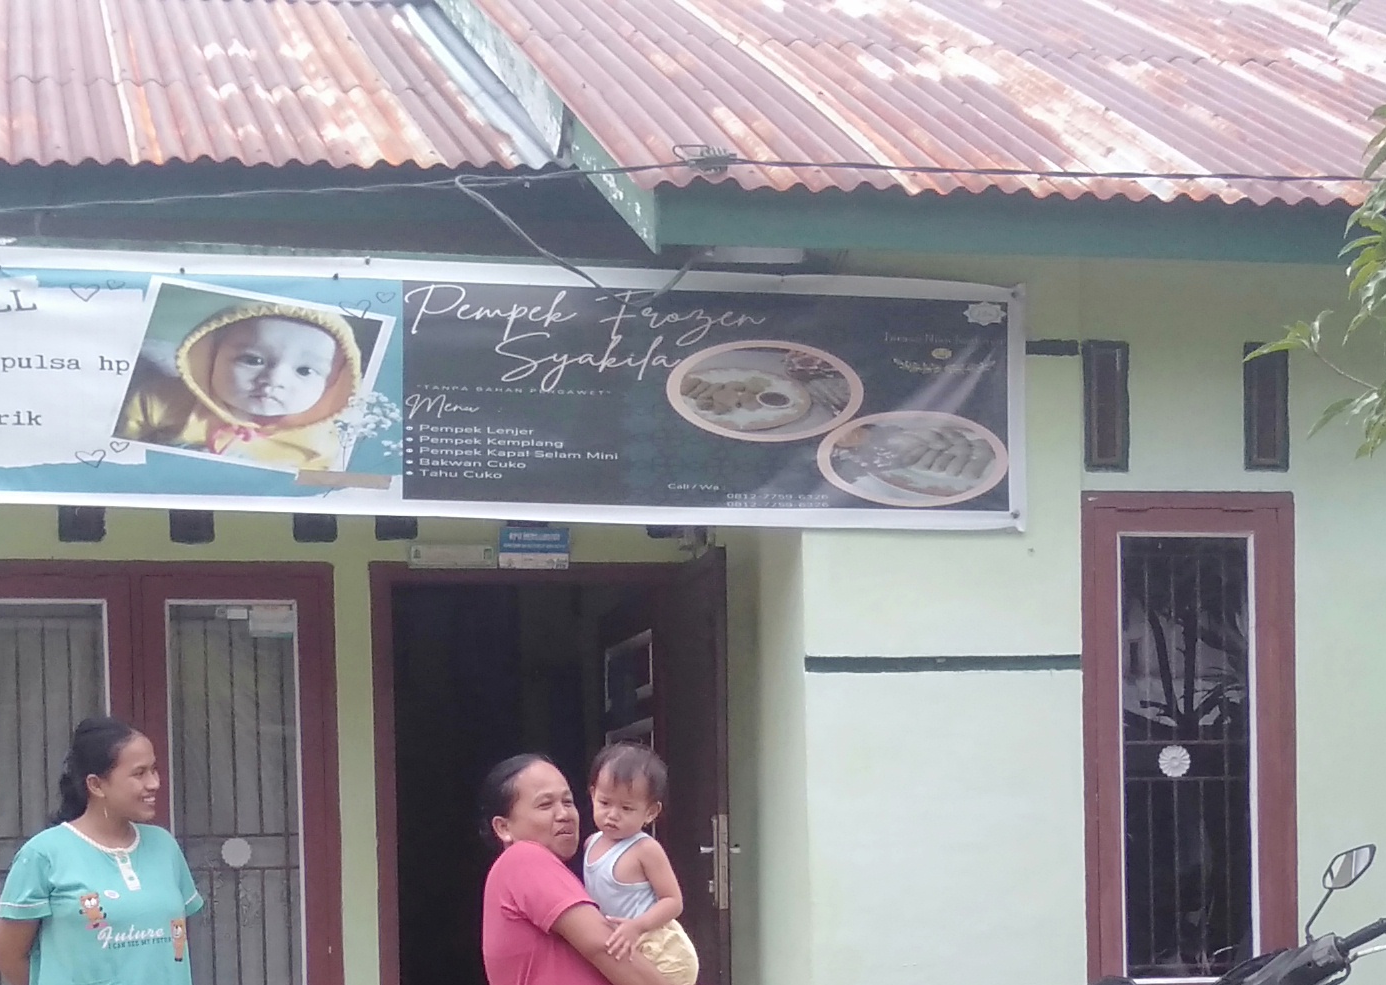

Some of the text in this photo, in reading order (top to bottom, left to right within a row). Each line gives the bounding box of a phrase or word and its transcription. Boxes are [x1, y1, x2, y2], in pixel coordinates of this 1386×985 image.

[403, 283, 767, 347] Pempek Frozen
[1, 354, 82, 373] pulsa
[98, 354, 131, 376] hp
[494, 331, 686, 392] Syakila
[475, 386, 523, 394] BAHAN
[404, 393, 480, 420] Menu
[419, 423, 534, 436] Pempek Lenjer
[419, 435, 564, 449] Pempek Kemplang
[419, 446, 619, 461] Pempek Kapal Selam Mini
[419, 458, 527, 469] Bakwan Cuko
[419, 469, 503, 480] Tahu Cuko
[96, 924, 165, 949] Future
[113, 941, 126, 949] CAN
[127, 940, 139, 948] SEE
